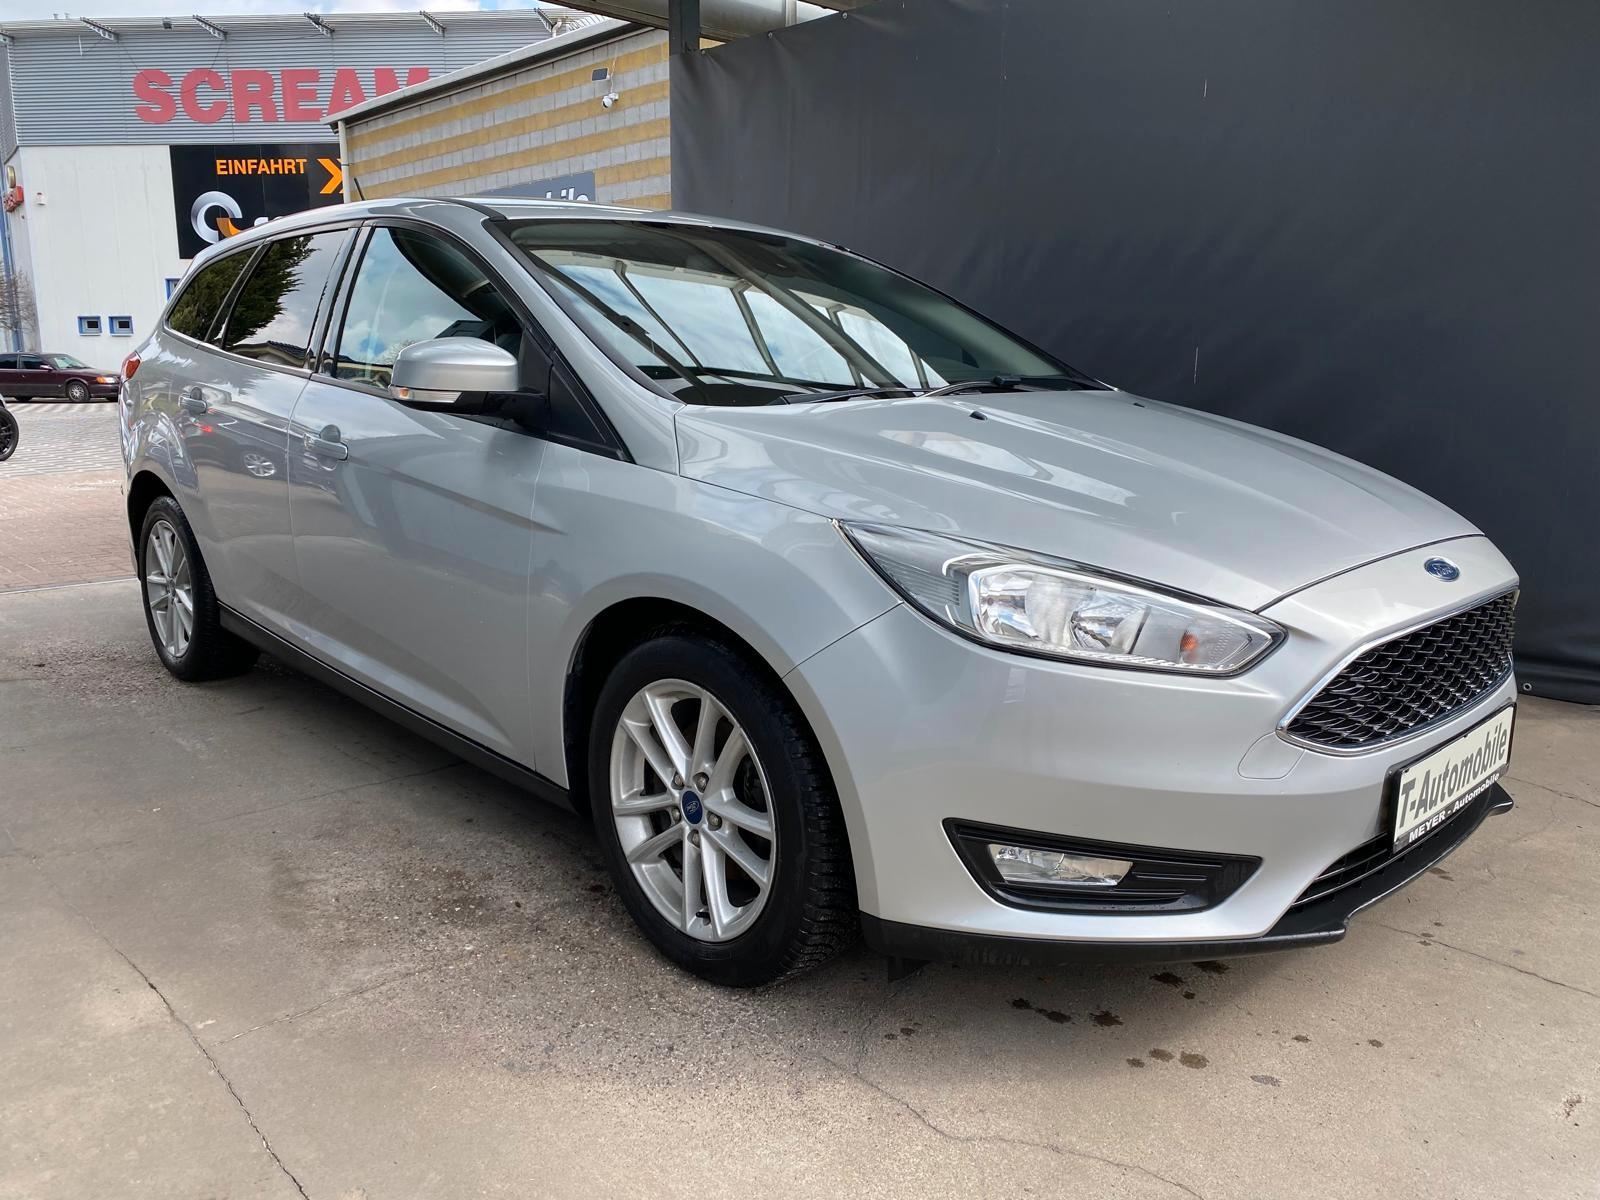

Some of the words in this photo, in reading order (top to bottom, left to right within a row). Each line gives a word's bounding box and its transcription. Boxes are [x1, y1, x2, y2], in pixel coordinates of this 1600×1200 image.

[215, 158, 308, 176] EINFAHRT
[1398, 721, 1508, 829] T-Automobile
[1408, 812, 1446, 843] MEYER
[1453, 772, 1500, 812] Automobile
